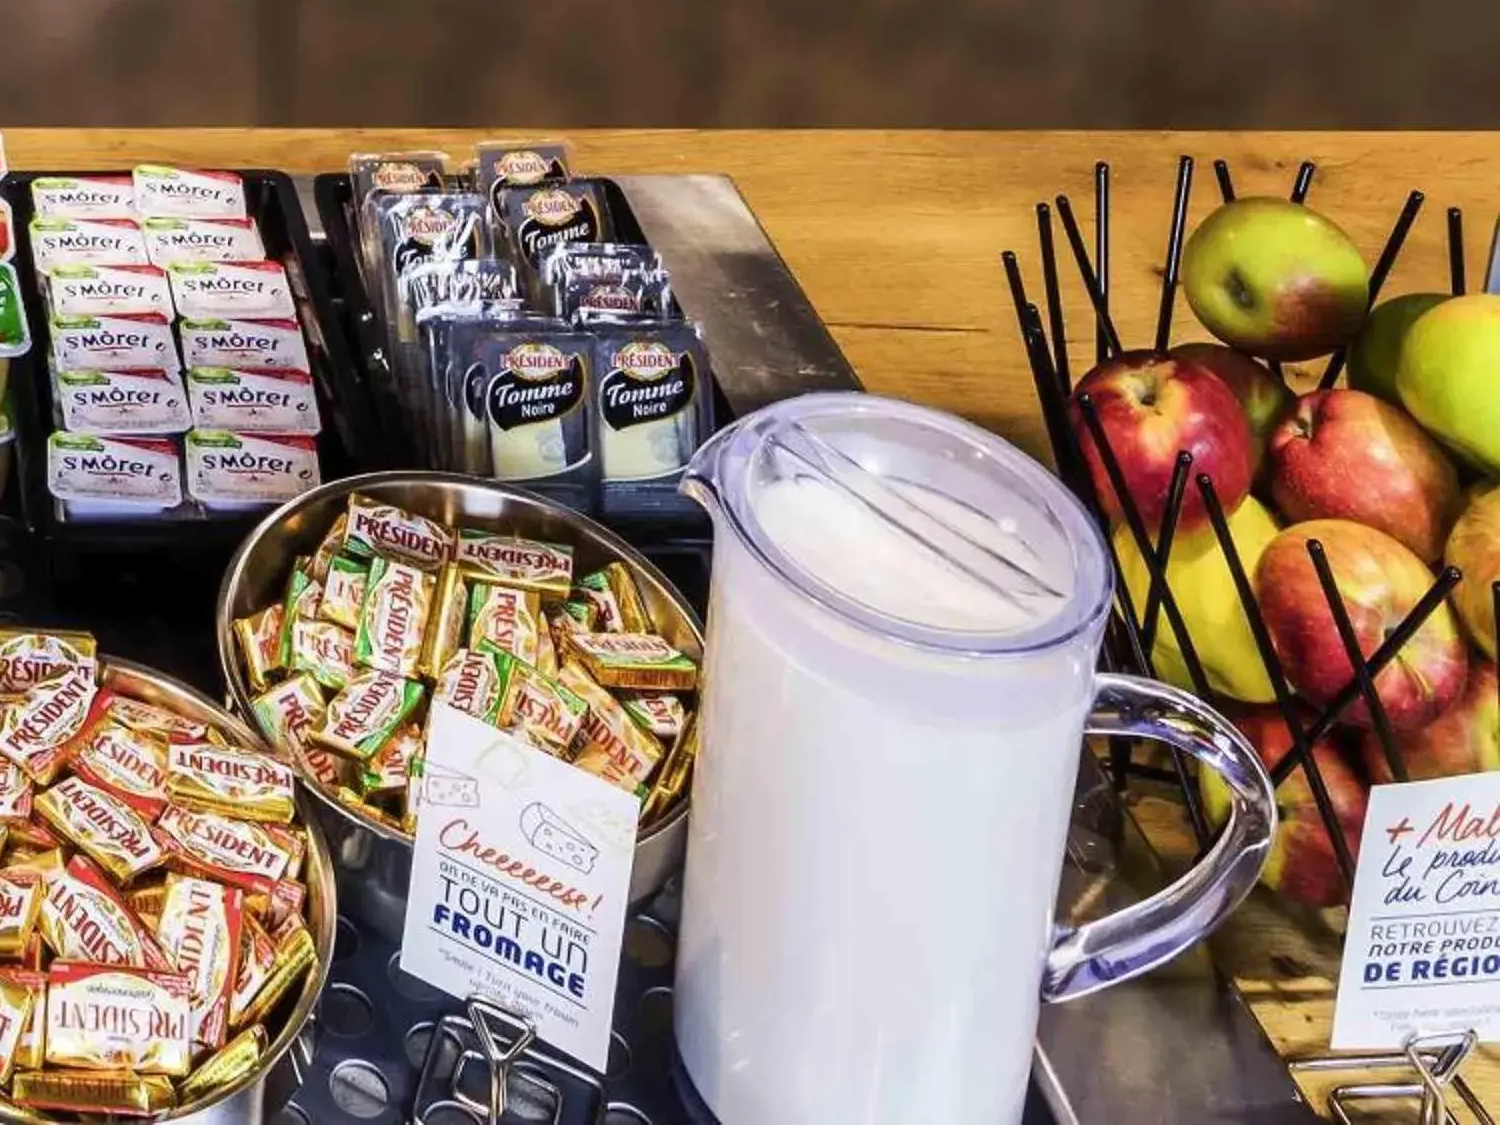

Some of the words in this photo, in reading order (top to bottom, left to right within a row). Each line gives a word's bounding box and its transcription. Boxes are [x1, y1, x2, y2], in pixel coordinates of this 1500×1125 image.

[524, 221, 590, 250] Tomme
[612, 350, 682, 368] PRÉSIDENT
[495, 381, 573, 407] Tomme
[606, 379, 684, 407] Tomme
[520, 401, 555, 418] Noire
[632, 400, 668, 418] Noire
[355, 514, 459, 559] PRÉSIDENT
[462, 543, 572, 572] PRÉSIDENT
[5, 677, 88, 752] PRÉSIDENT
[176, 749, 293, 790] PRÉSIDENT
[57, 782, 152, 860] PRÉSIDENT
[165, 803, 281, 870] PRÉSIDENT
[1383, 876, 1427, 906] du
[439, 874, 529, 939] TOUT
[541, 925, 588, 974] UN
[433, 902, 586, 999] FROMAGE
[1367, 939, 1436, 958] NOTRE
[1363, 961, 1401, 984] DE
[56, 1000, 185, 1041] PRÉSIDENT
